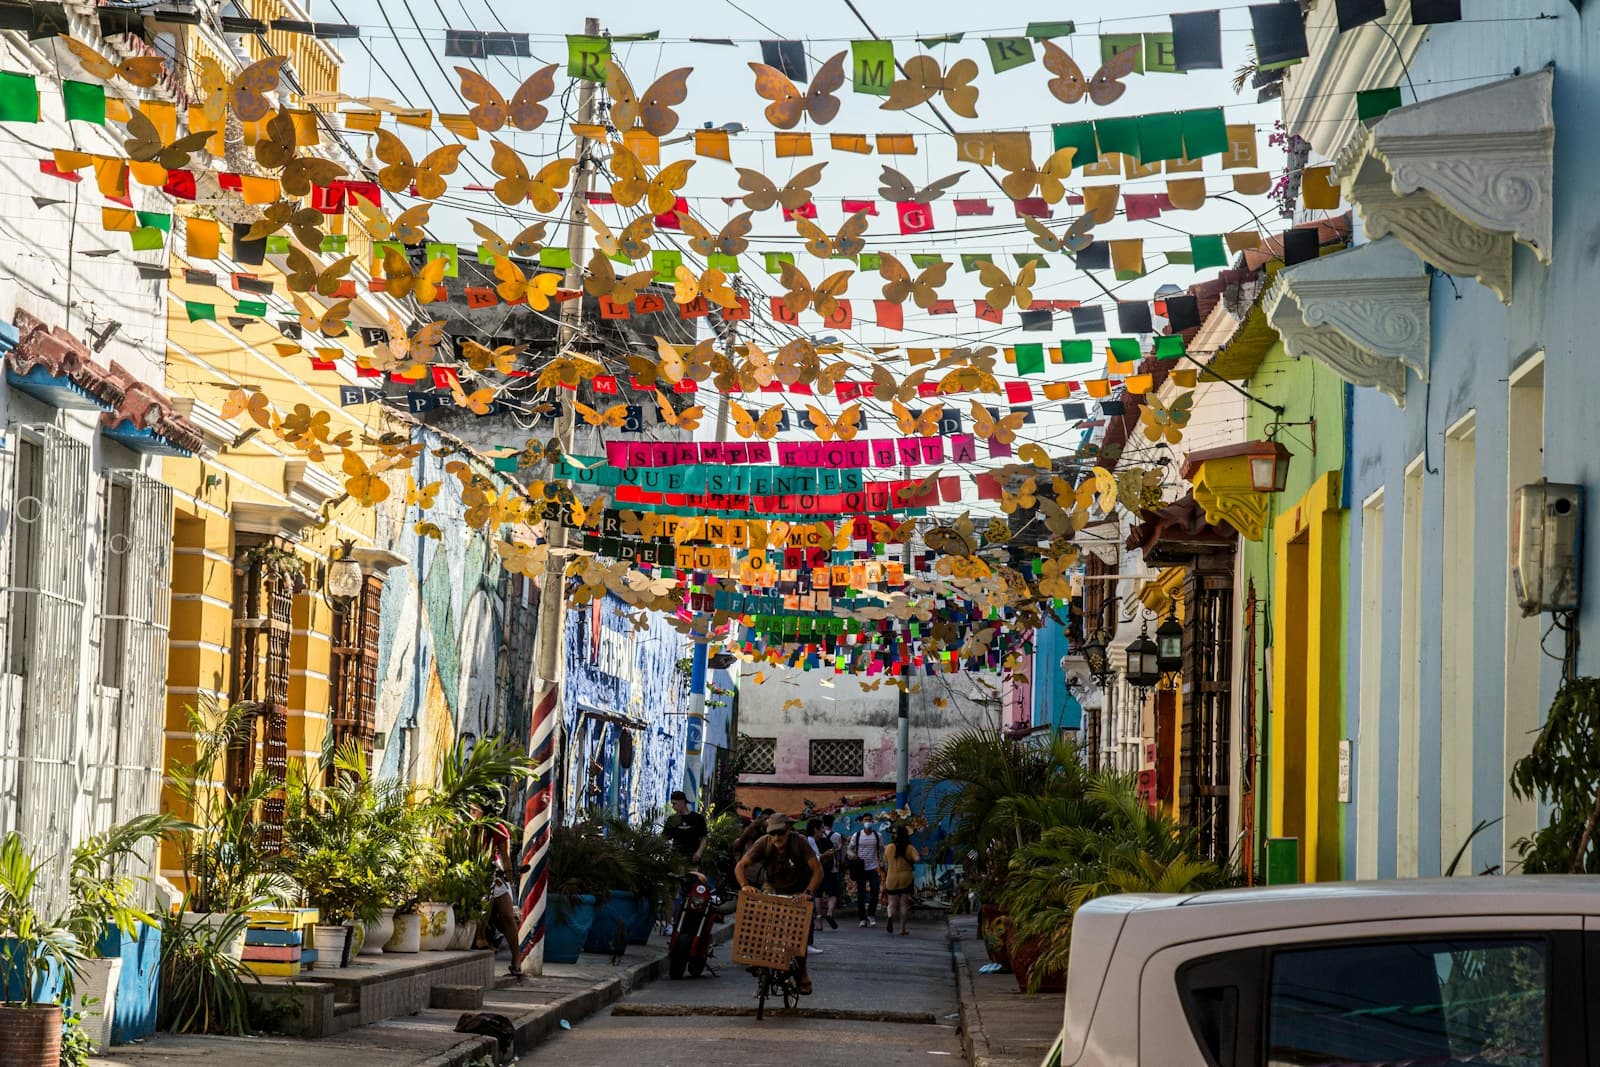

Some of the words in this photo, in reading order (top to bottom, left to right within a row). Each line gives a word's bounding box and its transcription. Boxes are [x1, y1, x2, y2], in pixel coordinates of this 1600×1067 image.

[558, 461, 594, 482] LO
[623, 468, 682, 490] QUE
[712, 473, 858, 494] SIENTES
